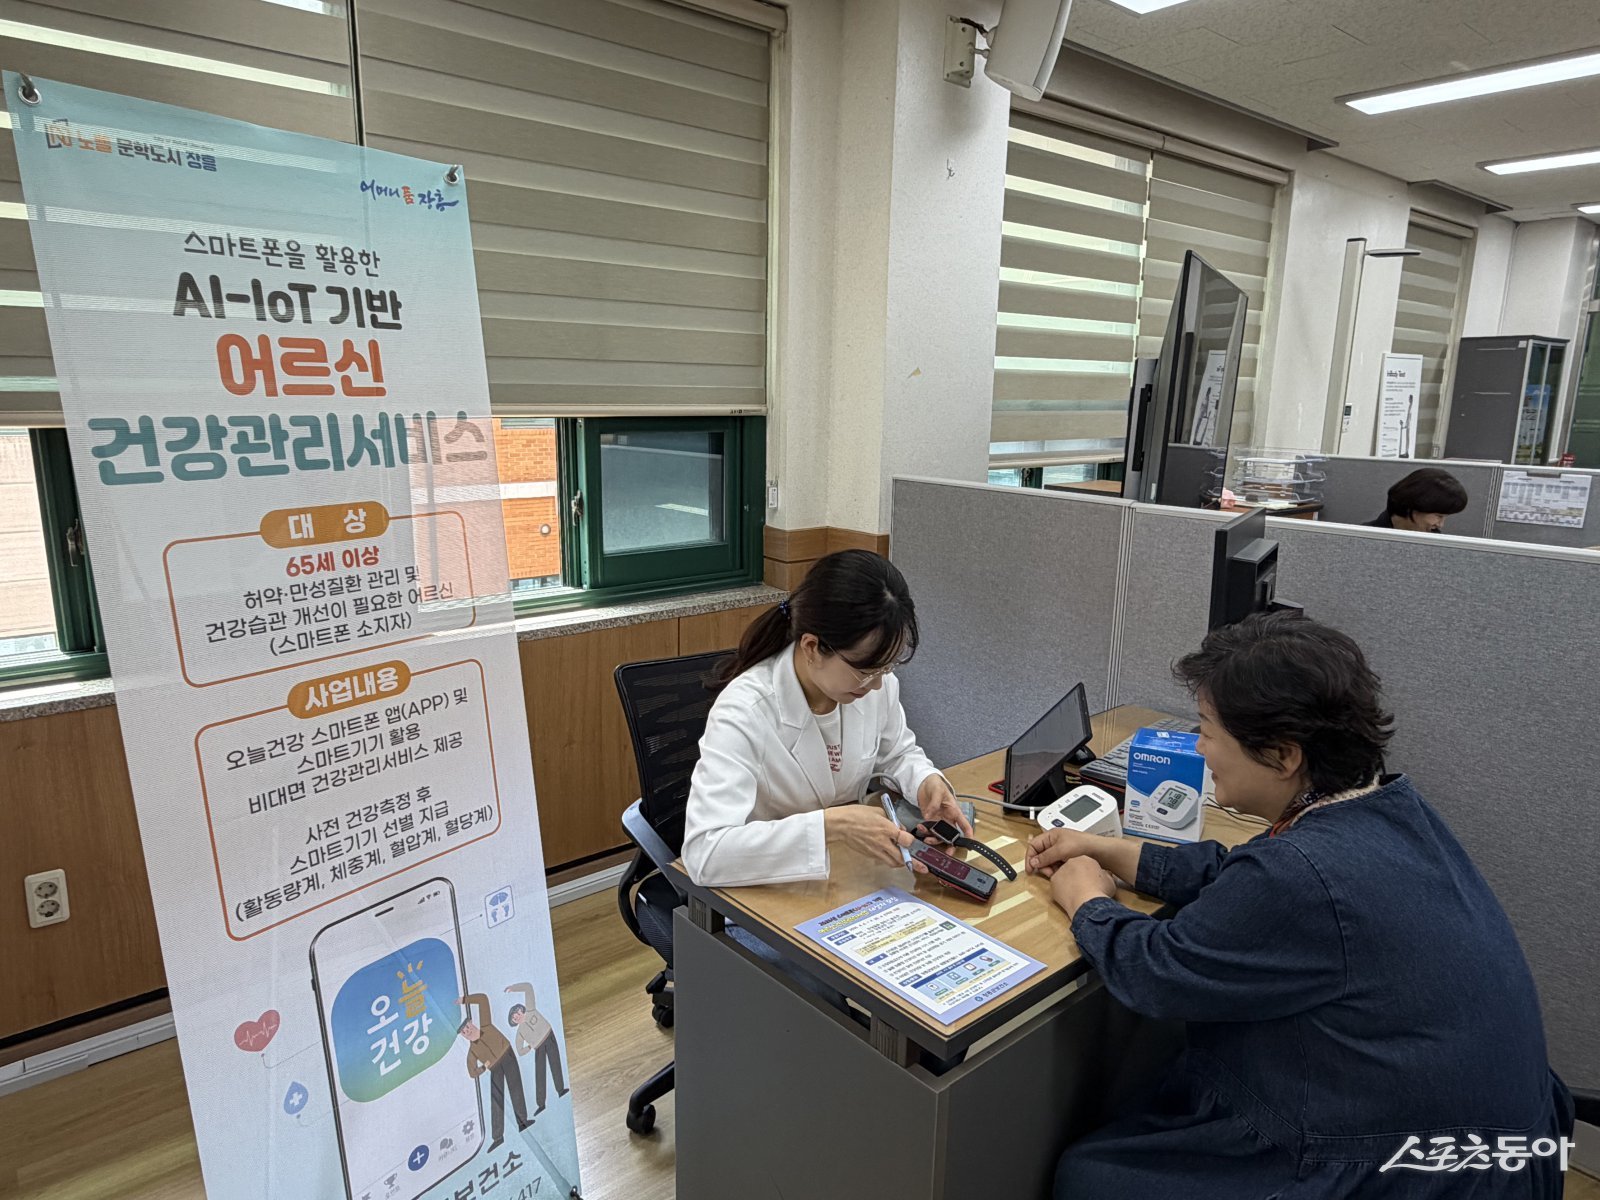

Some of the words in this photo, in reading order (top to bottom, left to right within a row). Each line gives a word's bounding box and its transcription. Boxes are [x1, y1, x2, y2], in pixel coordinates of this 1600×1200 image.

[186, 150, 217, 172] 장흥
[184, 231, 306, 270] 스마트폰을
[315, 243, 381, 277] 활용한
[173, 272, 317, 324] AI-IoT
[329, 286, 402, 330] 기반
[216, 333, 387, 397] 어르신
[88, 410, 488, 485] 건강관리서비스
[288, 514, 315, 540] 대
[343, 508, 368, 534] 상
[244, 573, 362, 610] 허약·만성질환
[367, 567, 401, 590] 관리
[404, 565, 421, 583] 및
[285, 551, 335, 578] 65세
[341, 545, 380, 569] 이상
[205, 611, 288, 644] 건강습관
[293, 601, 349, 627] 개선이
[352, 591, 404, 616] 필요한
[408, 582, 455, 605] 어르신
[269, 623, 352, 657] (스마트폰
[356, 611, 413, 639] 소지자)
[303, 665, 399, 712] 사업내용
[225, 731, 305, 772] 오늘건강
[310, 710, 381, 747] 스마트폰
[385, 691, 450, 725] 앱(APP)
[452, 686, 470, 705] 및
[296, 731, 385, 775] 스마트기기
[388, 722, 422, 747] 활용
[1133, 752, 1171, 765] OMRON
[248, 780, 307, 815] 비대면
[311, 747, 430, 795] 건강관리서비스
[433, 730, 464, 754] 제공
[289, 828, 378, 877] 스마트기기
[382, 811, 415, 839] 선별
[418, 799, 450, 826] 지급
[305, 819, 341, 846] 사전
[345, 793, 411, 823] 건강측정
[415, 785, 433, 805] 후
[234, 876, 326, 923] (활동량계,
[330, 849, 386, 884] 체중계,
[389, 827, 442, 859] 혈압계,
[443, 803, 495, 837] 혈당계)
[366, 960, 428, 1035] 오늘
[370, 1012, 433, 1077] 건강
